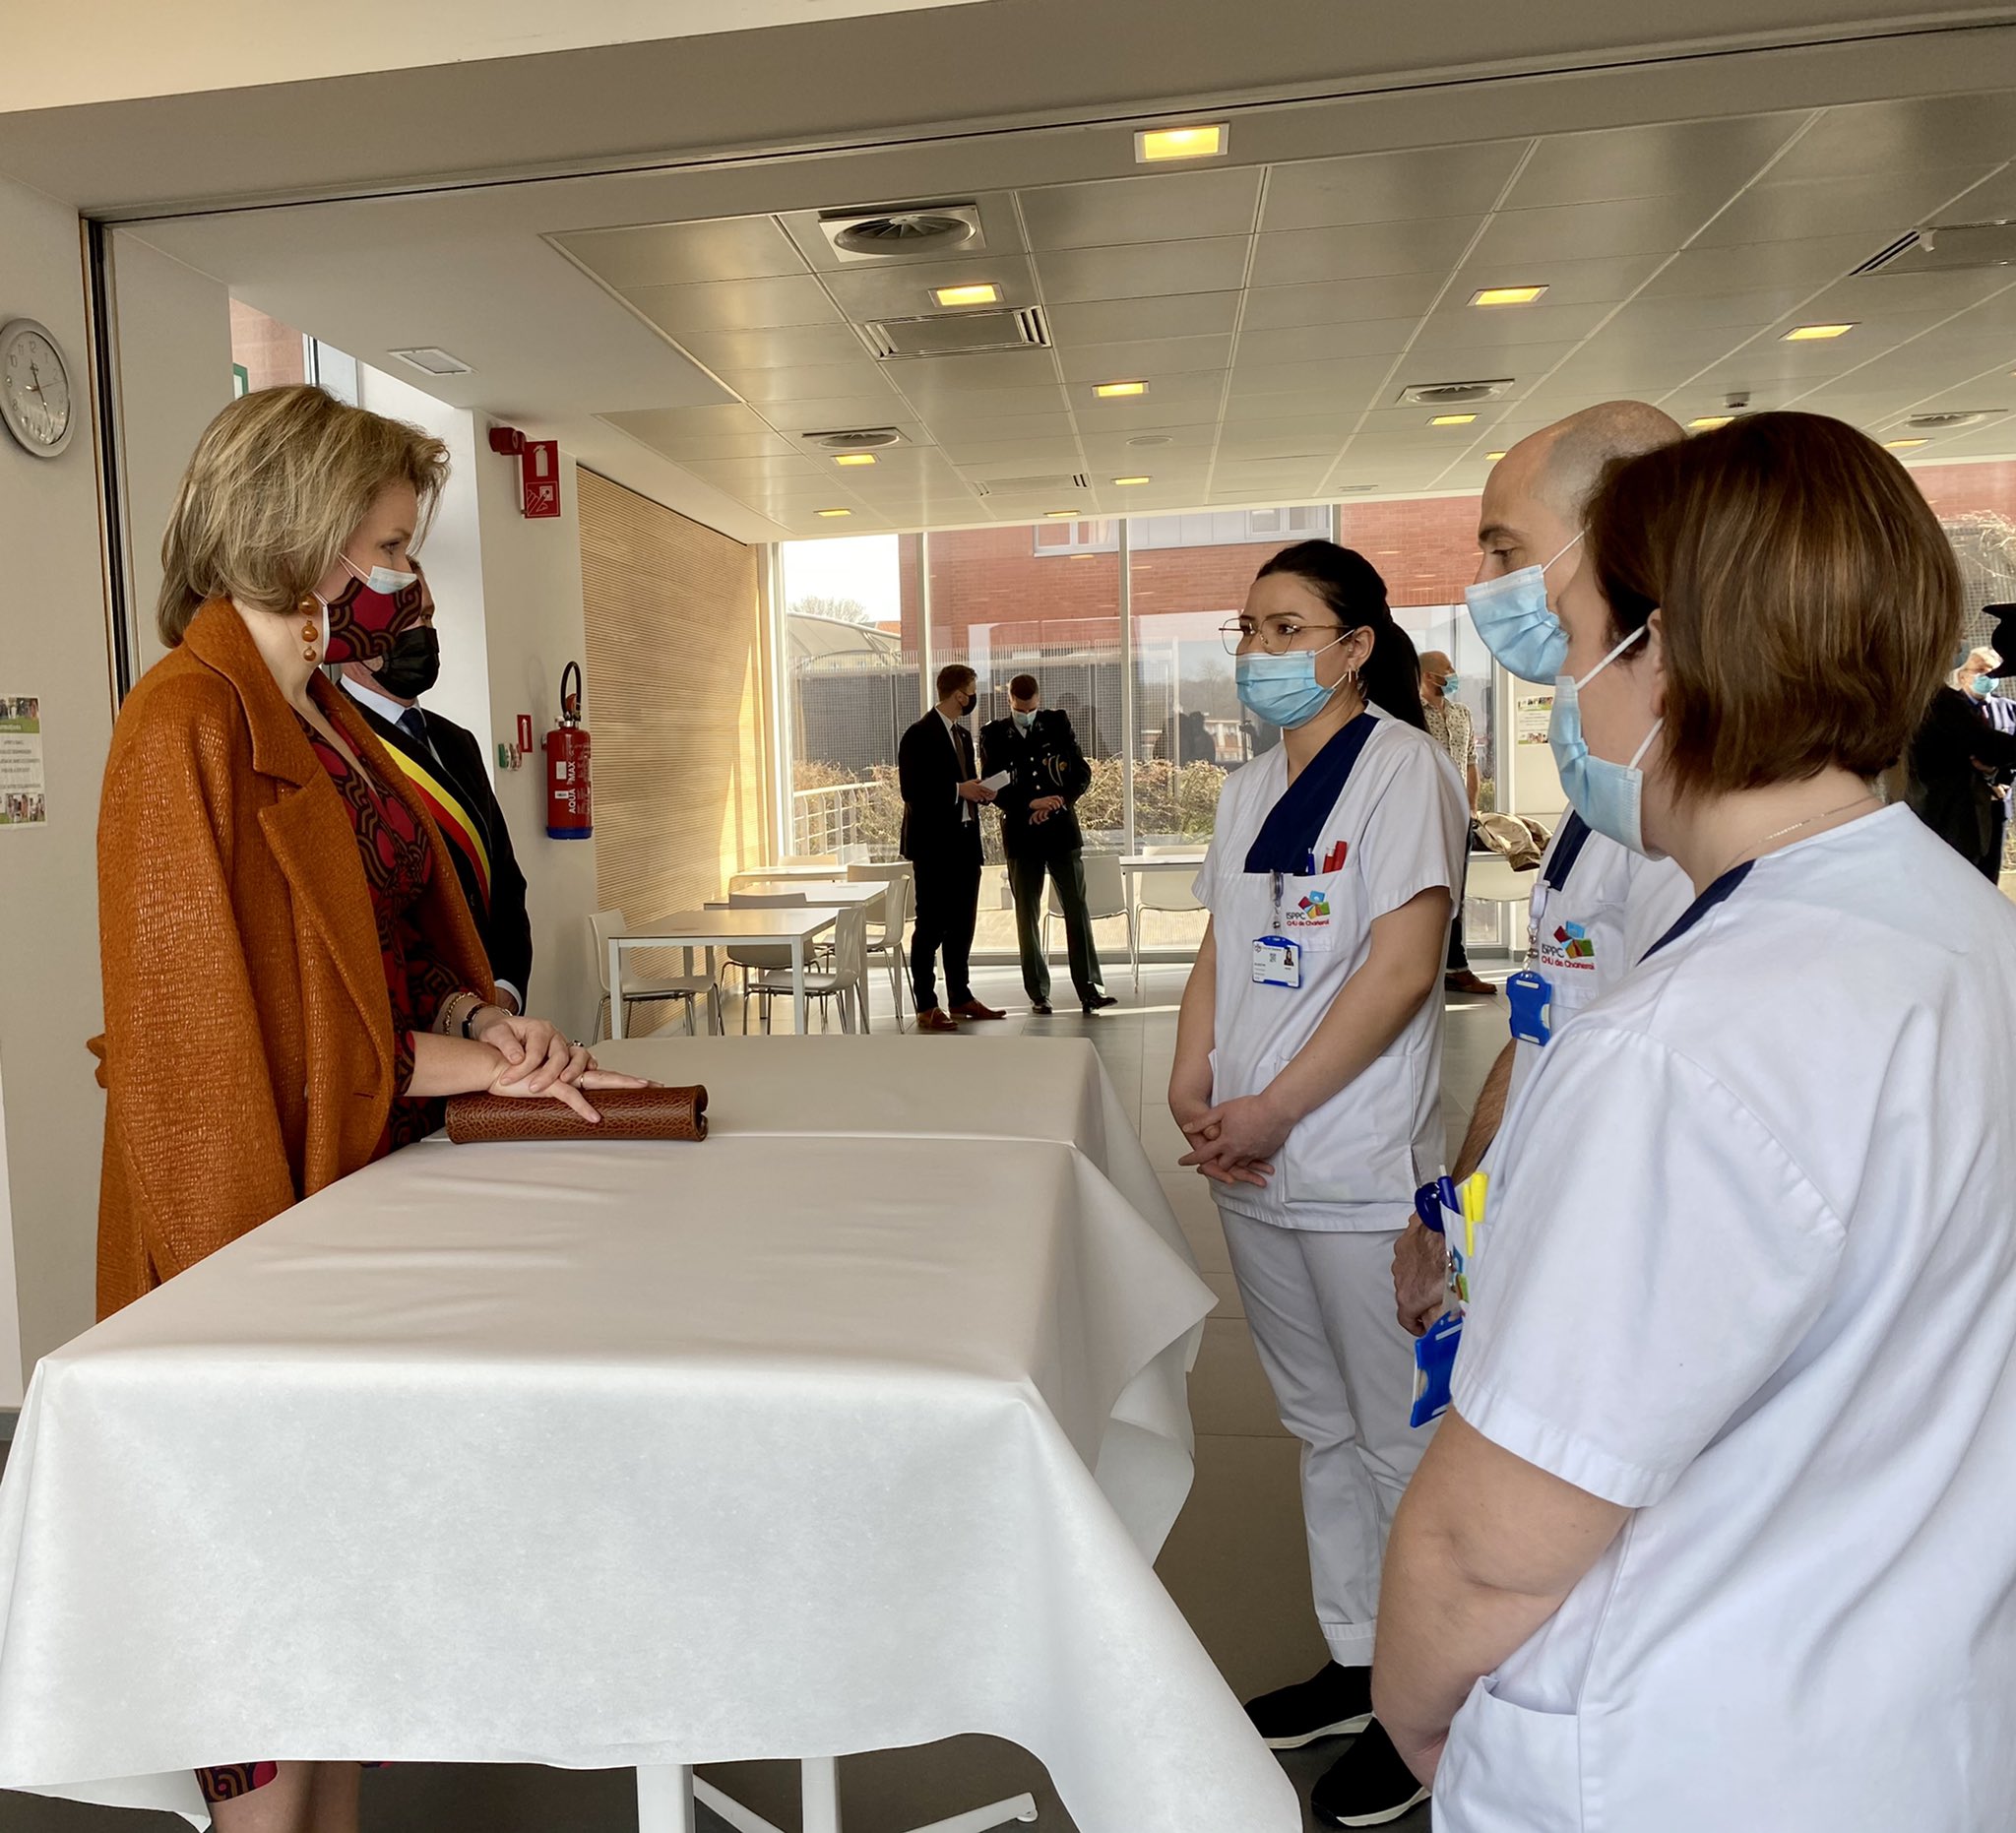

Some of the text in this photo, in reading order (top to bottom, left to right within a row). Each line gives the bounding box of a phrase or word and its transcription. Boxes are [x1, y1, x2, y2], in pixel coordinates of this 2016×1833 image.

[29, 340, 36, 354] 12
[1286, 912, 1306, 920] ISPPC
[1542, 943, 1564, 958] ISPPC
